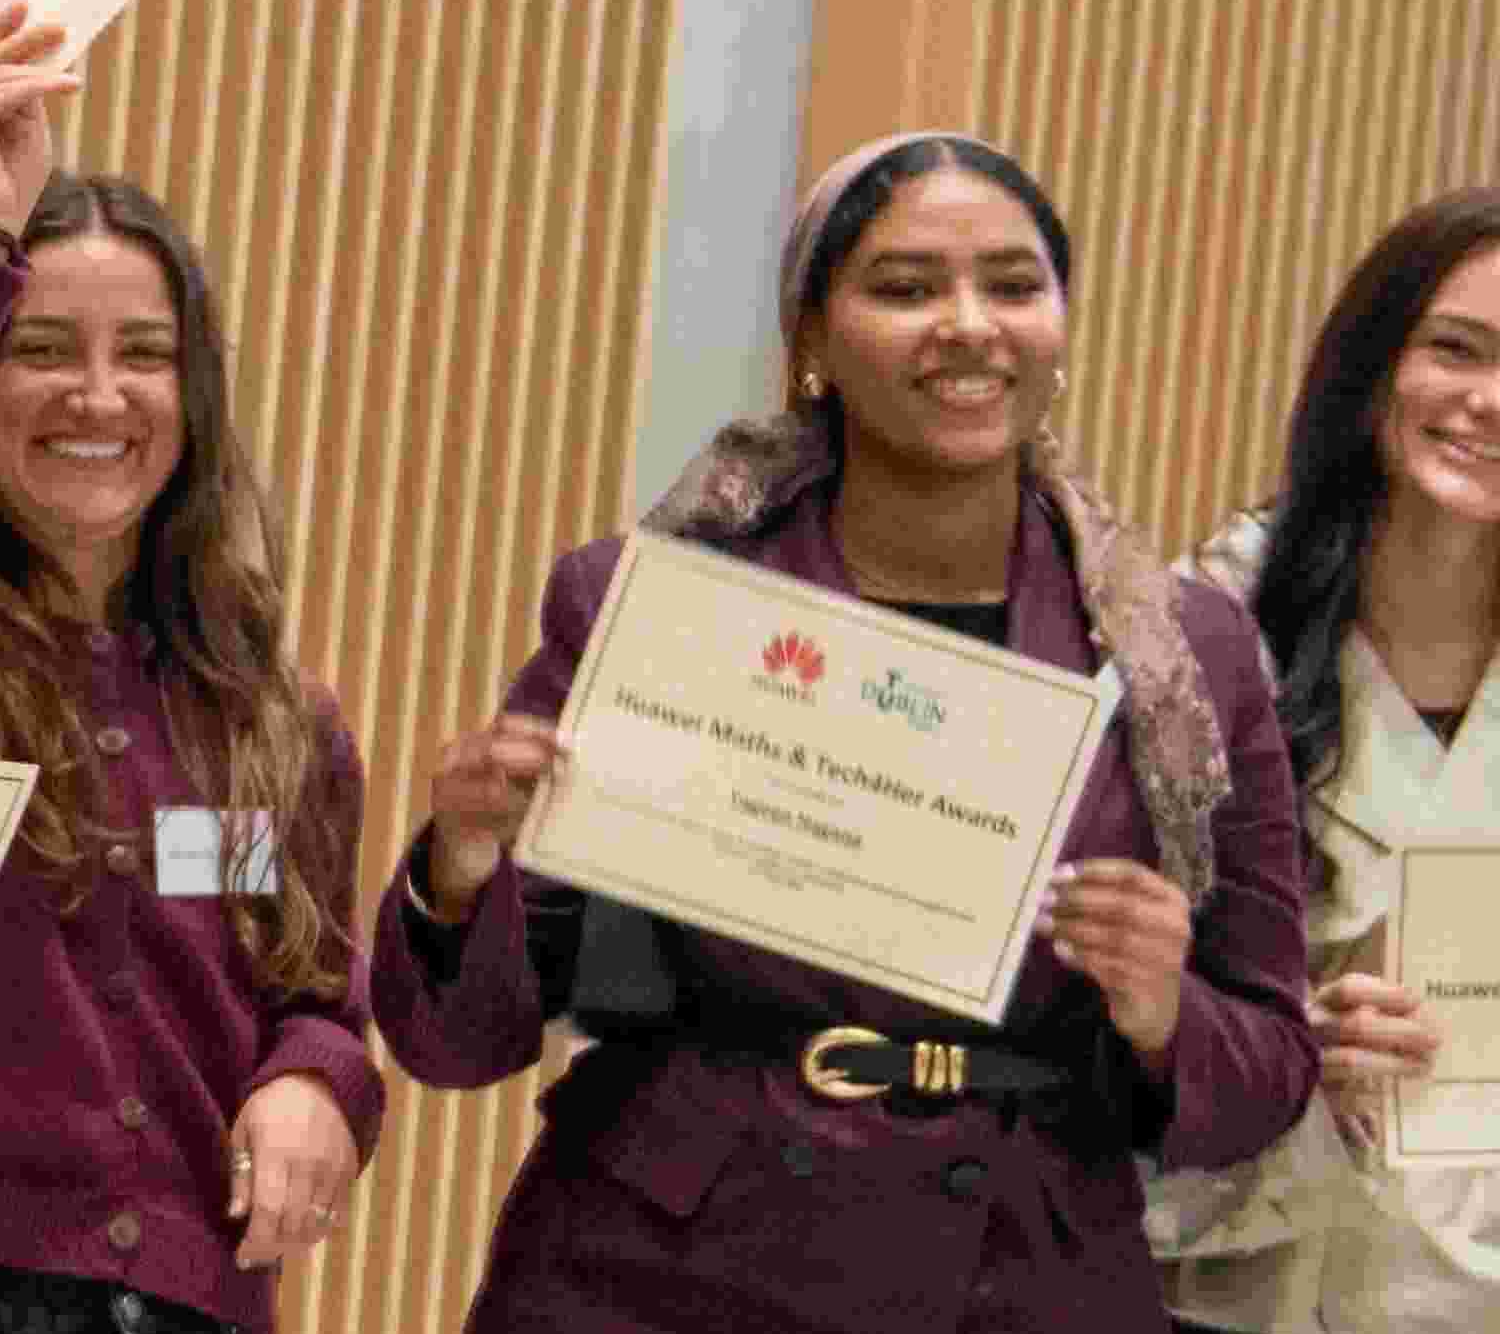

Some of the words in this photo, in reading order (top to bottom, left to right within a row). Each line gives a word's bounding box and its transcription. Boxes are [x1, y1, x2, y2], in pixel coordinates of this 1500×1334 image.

[613, 684, 703, 736] Huawei
[709, 715, 782, 762] Maths
[788, 744, 807, 770] &
[815, 752, 924, 811] Tech4Her
[928, 793, 1021, 842] Awards
